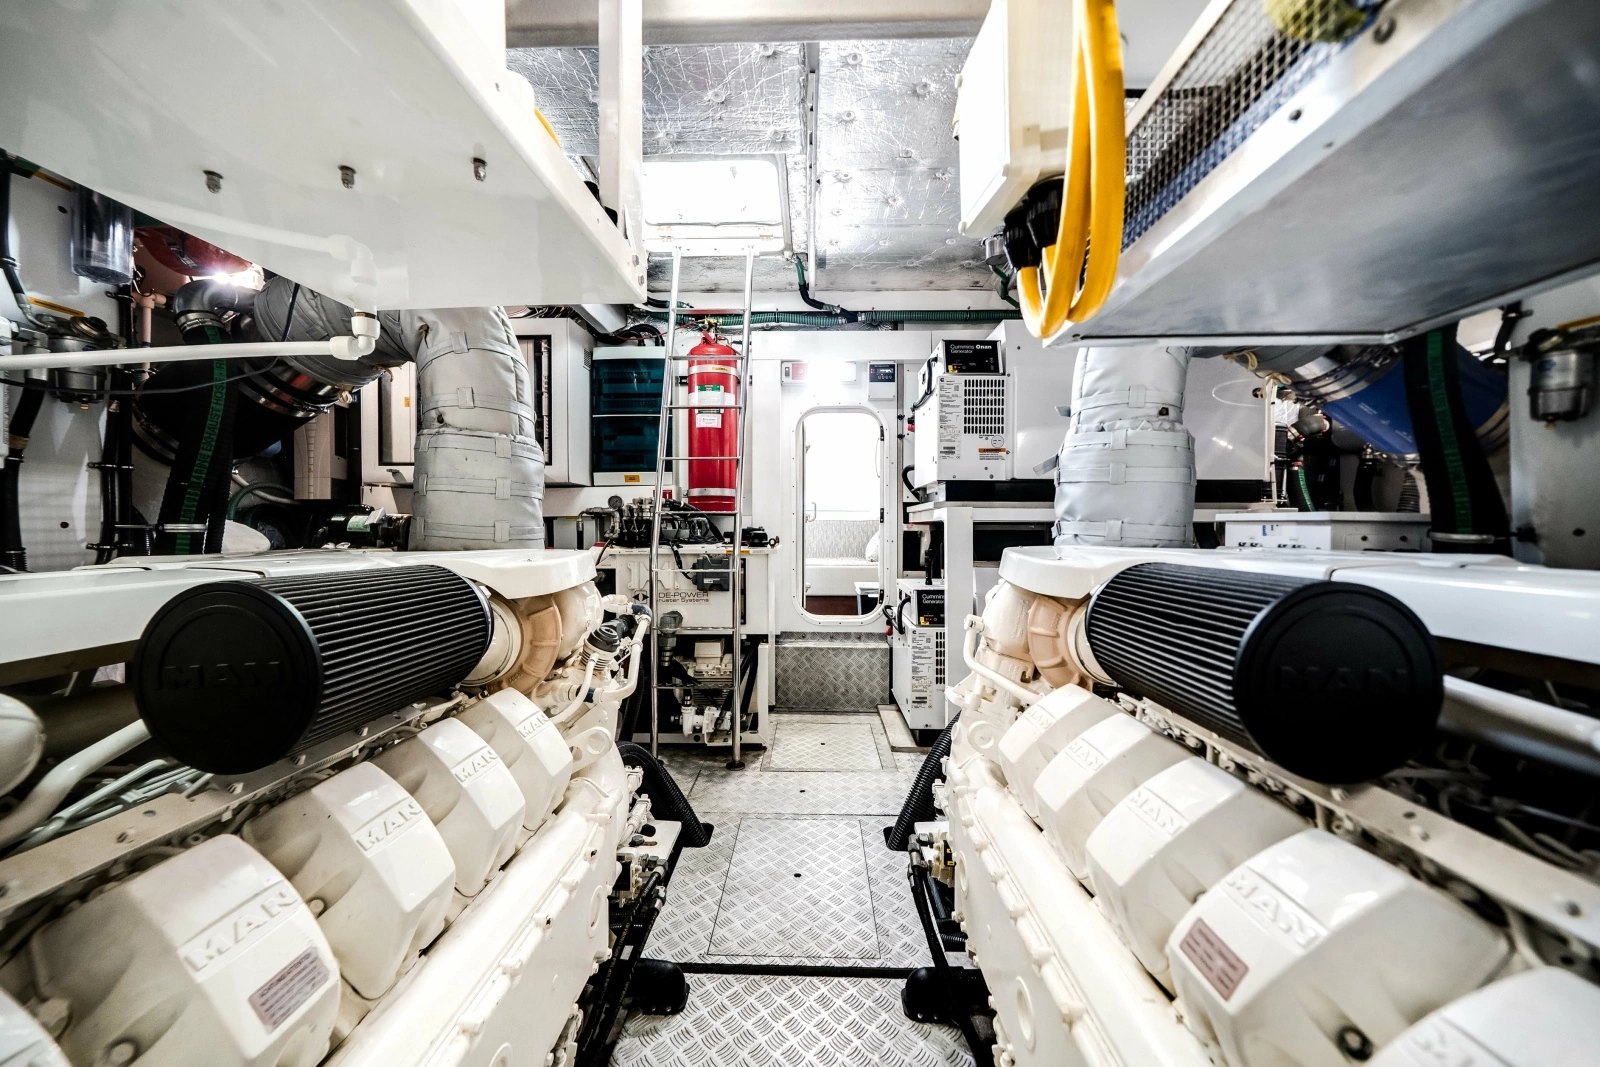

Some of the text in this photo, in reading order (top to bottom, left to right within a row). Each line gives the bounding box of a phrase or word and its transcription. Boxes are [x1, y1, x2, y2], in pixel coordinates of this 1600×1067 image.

[518, 714, 550, 738] MAN
[454, 749, 499, 783] MAN
[356, 800, 423, 852] MAN
[1127, 789, 1184, 837] MAN
[184, 888, 299, 973] MAN
[1225, 872, 1319, 950] MAN
